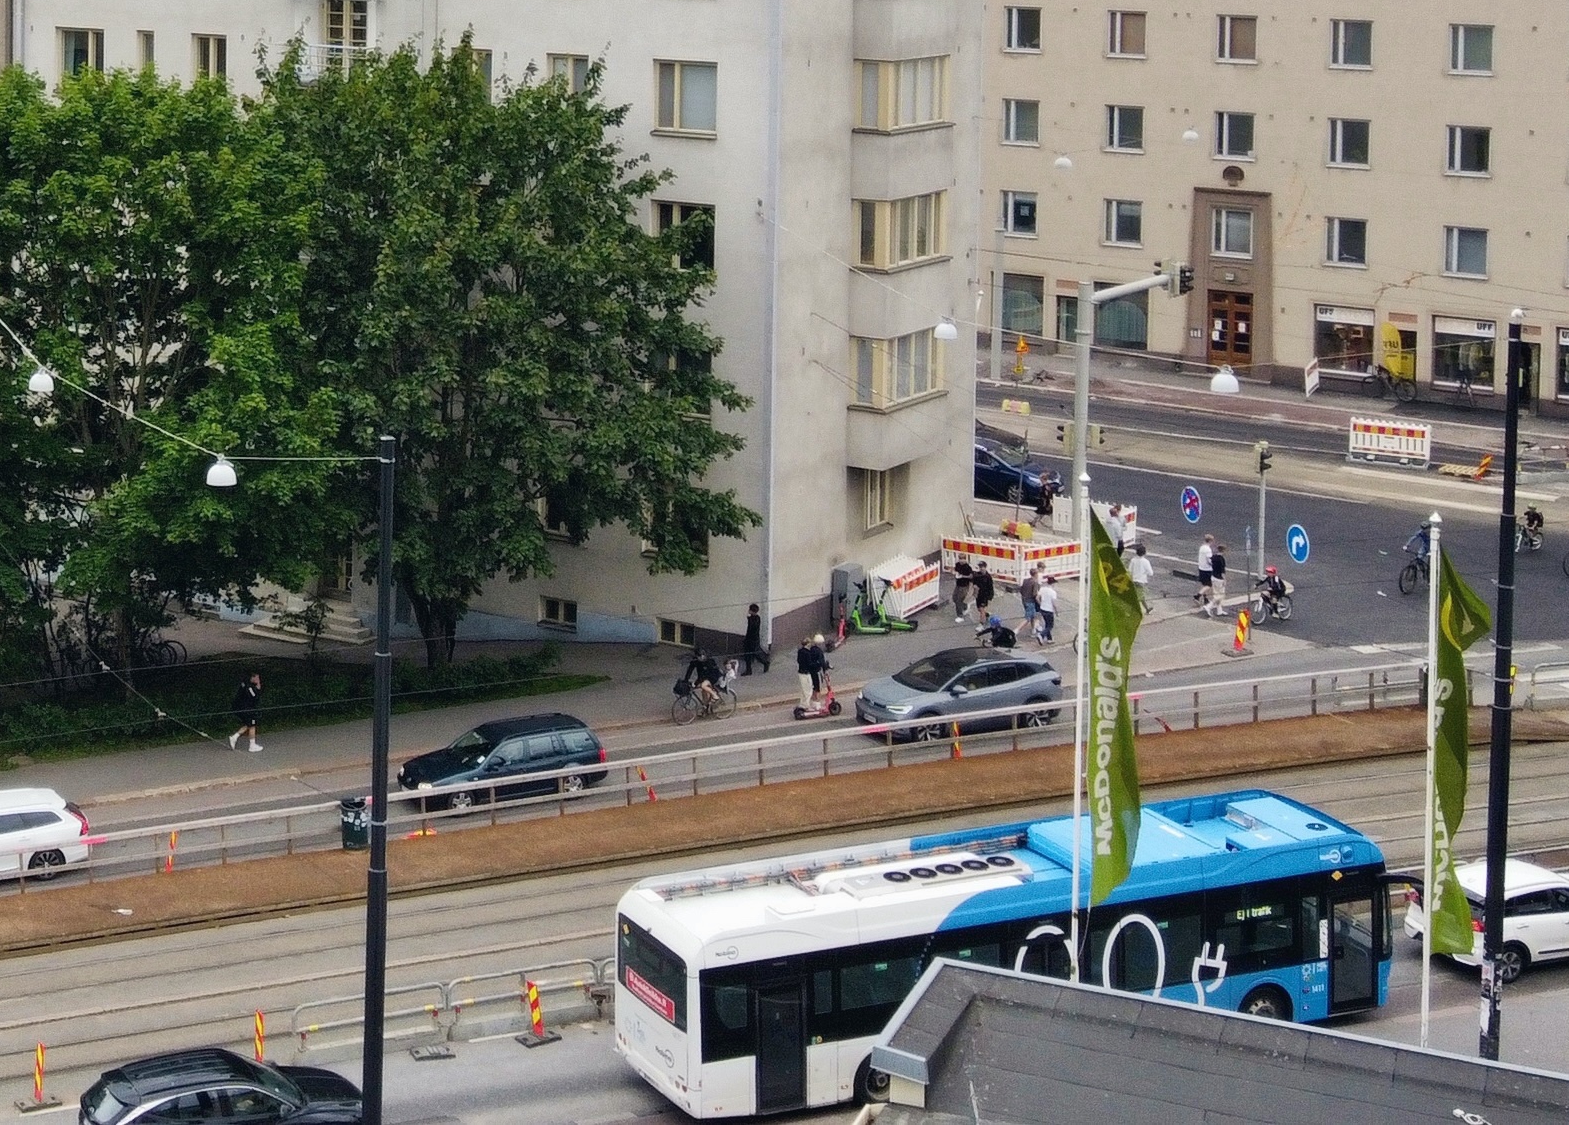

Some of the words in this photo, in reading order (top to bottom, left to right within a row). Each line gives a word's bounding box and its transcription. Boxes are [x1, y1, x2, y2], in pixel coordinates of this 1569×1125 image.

[1477, 322, 1492, 331] UFF
[1093, 636, 1123, 856] McDonald's
[1236, 909, 1245, 921] Ej
[1251, 905, 1272, 918] trafik
